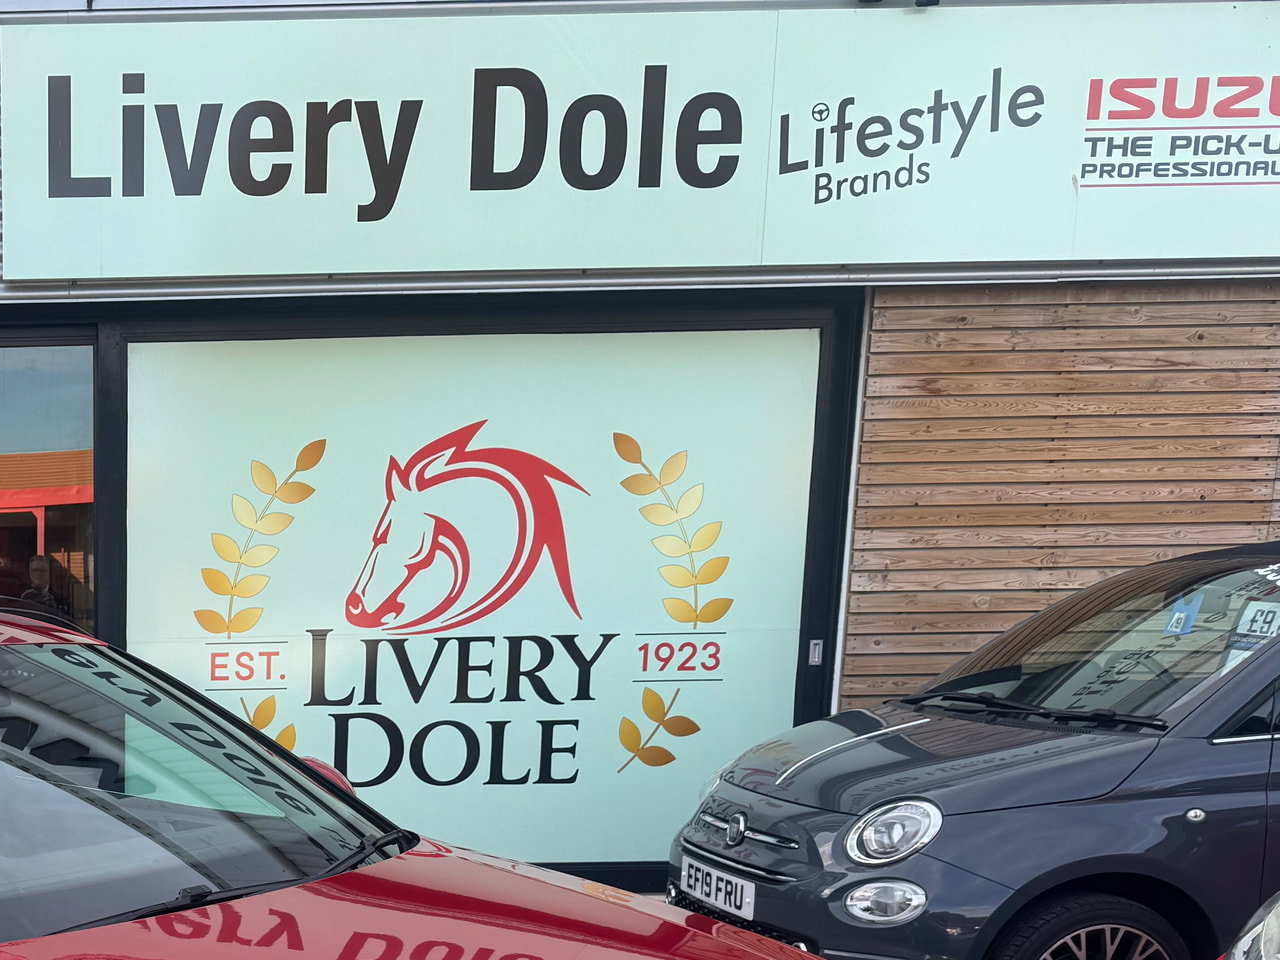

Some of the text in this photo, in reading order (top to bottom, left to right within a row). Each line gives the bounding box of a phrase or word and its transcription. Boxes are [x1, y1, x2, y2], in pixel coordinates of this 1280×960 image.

[47, 64, 743, 222] Livery Dole
[778, 67, 1045, 175] Lifestyle
[1084, 135, 1154, 158] THE
[813, 153, 932, 205] Brands
[210, 650, 287, 683] EST.
[303, 628, 621, 708] LIVERY
[637, 641, 722, 673] 1923
[328, 712, 580, 789] DOLE
[686, 863, 745, 912] EF19 FRU
